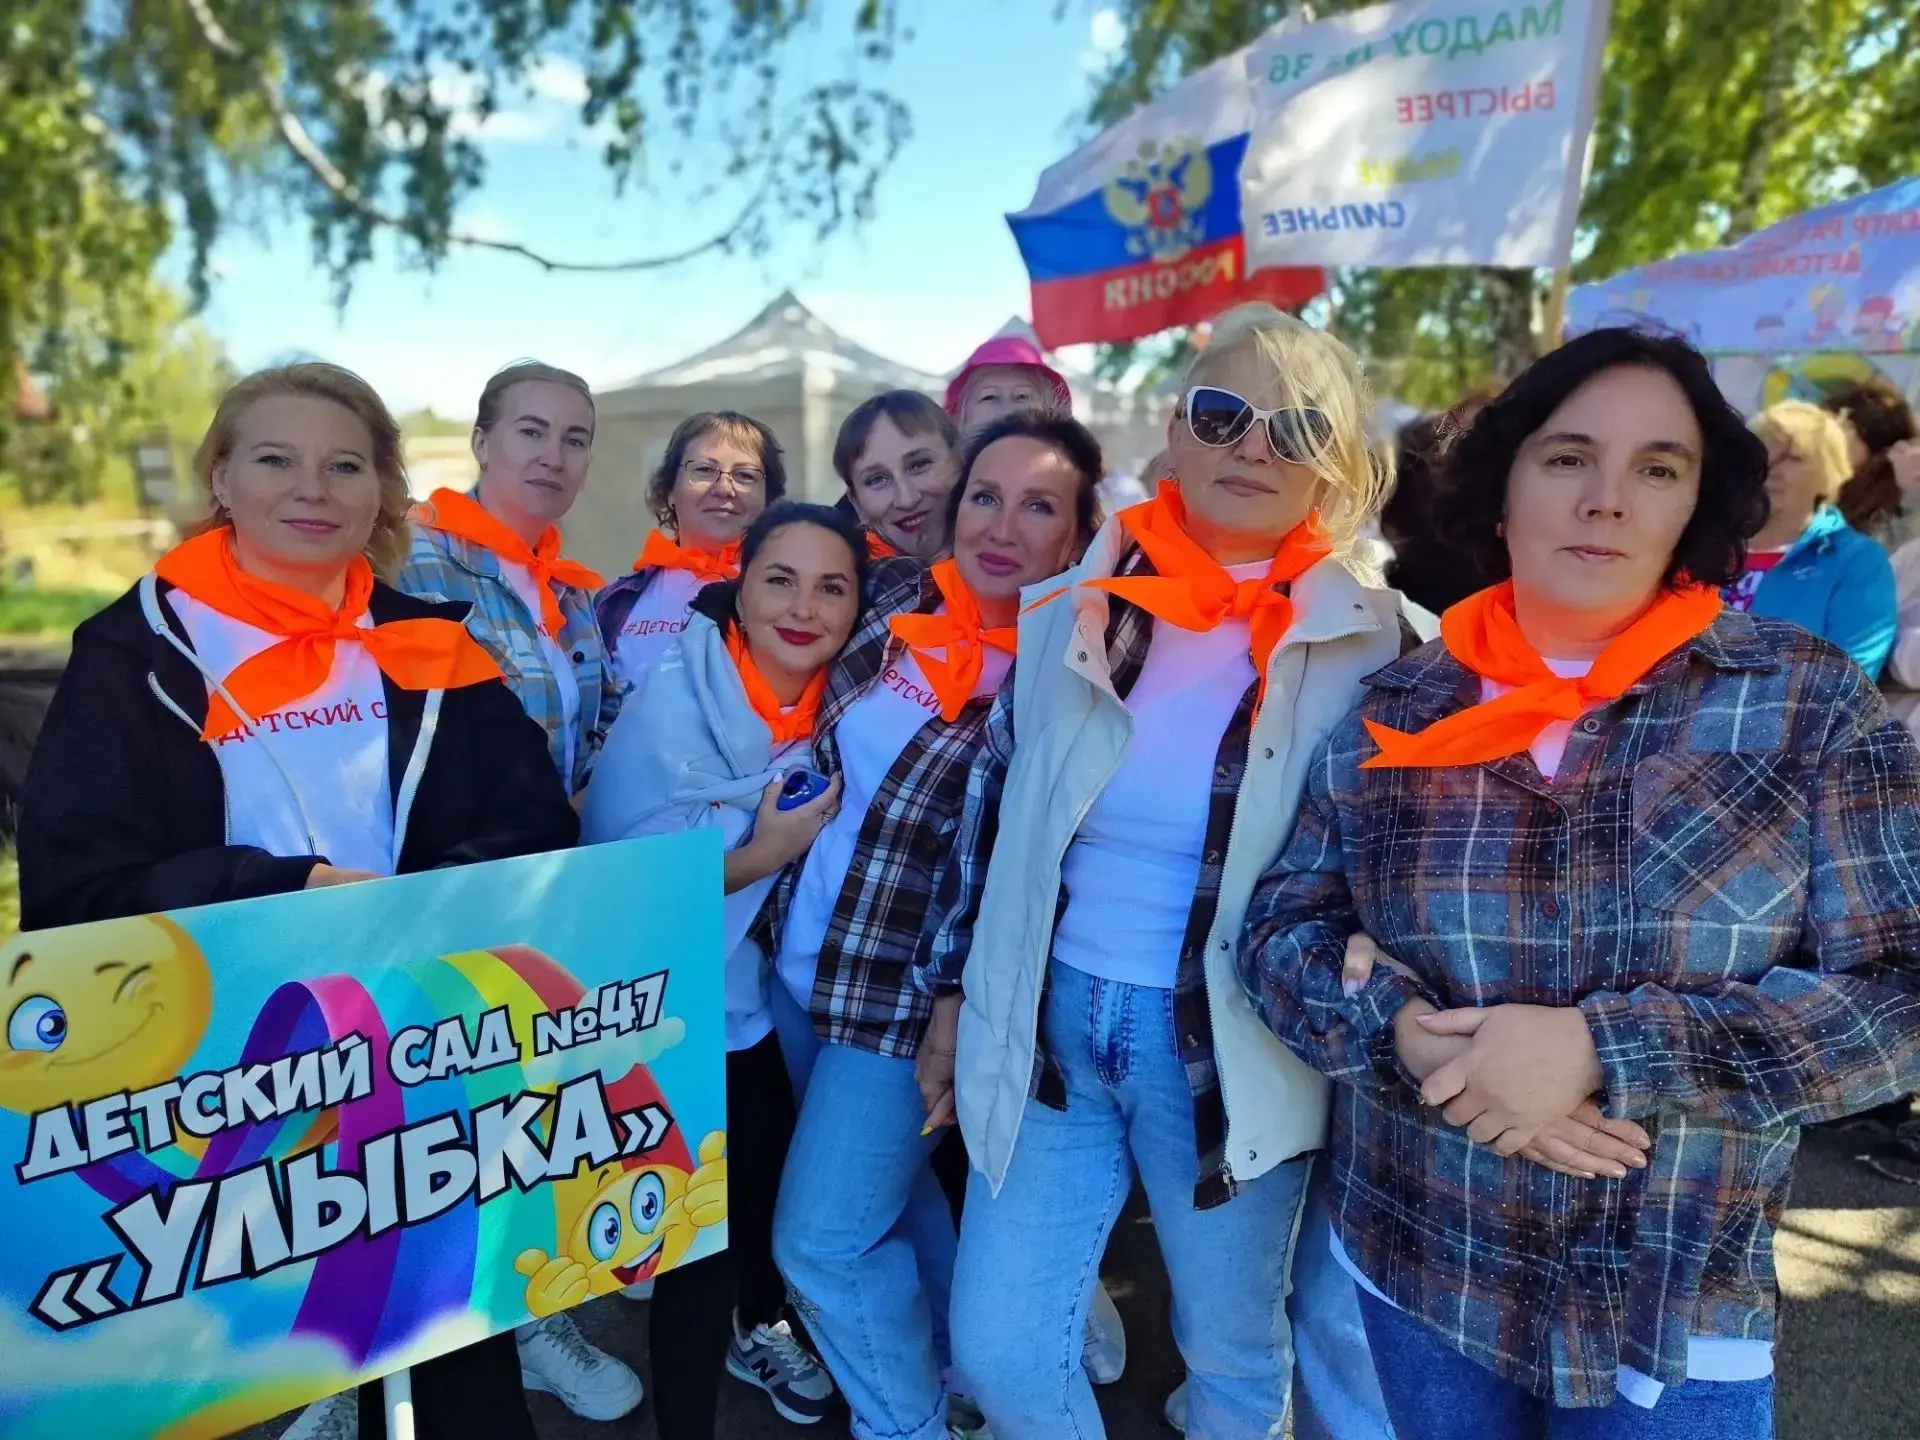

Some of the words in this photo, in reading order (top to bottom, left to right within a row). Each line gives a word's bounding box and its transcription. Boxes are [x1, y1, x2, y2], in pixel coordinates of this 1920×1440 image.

[18, 1033, 373, 1183] ДЕТСКИЙ
[387, 1006, 519, 1084] САД
[532, 970, 669, 1057] №47
[28, 1071, 675, 1331] «УЛЫБКА»
